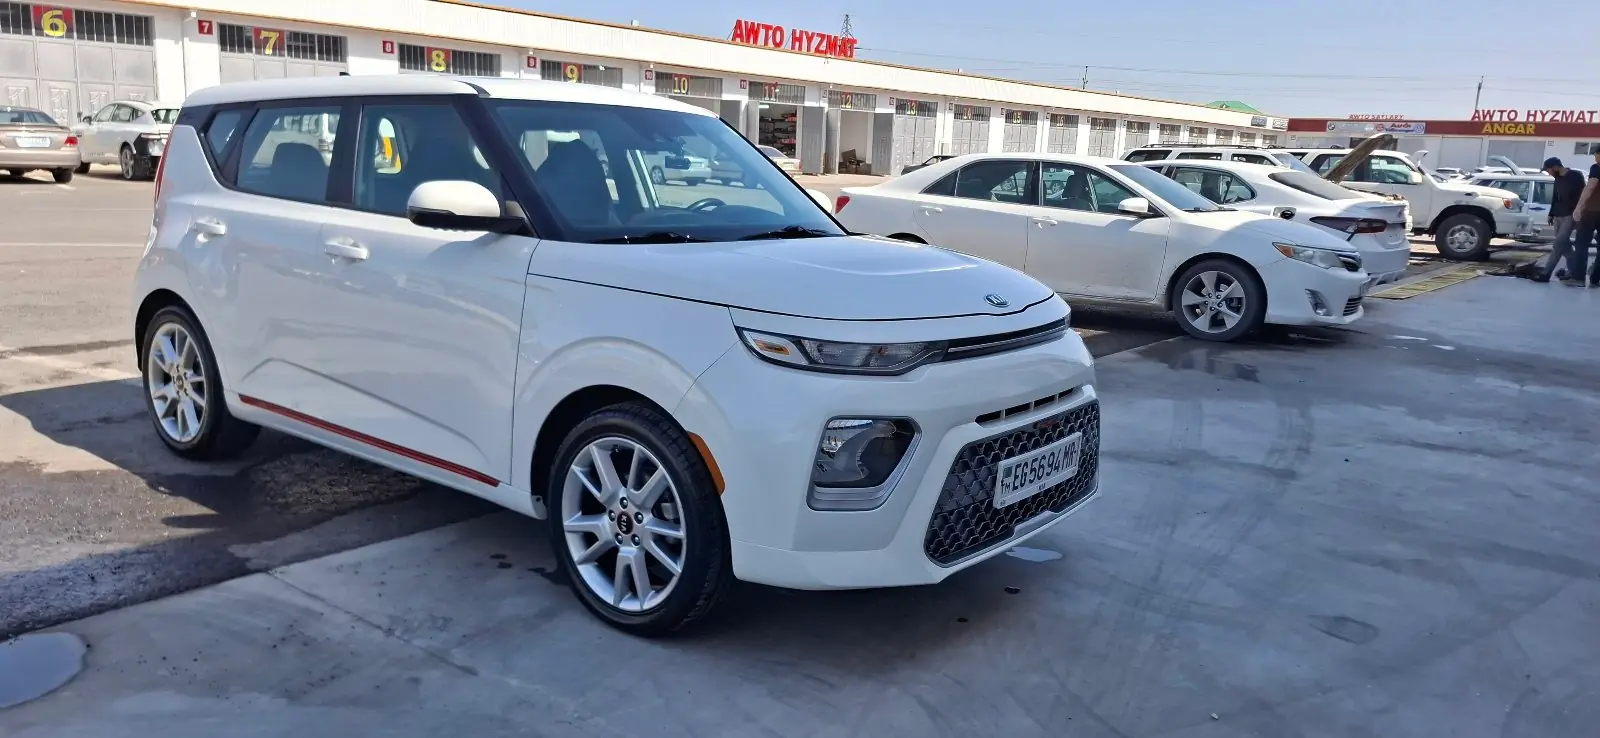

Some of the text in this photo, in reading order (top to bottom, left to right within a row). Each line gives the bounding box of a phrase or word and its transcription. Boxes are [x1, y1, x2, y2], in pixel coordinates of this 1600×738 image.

[41, 10, 67, 37] 6
[202, 22, 210, 33] 7
[259, 30, 280, 56] 7
[732, 19, 857, 58] AWTO HYZMAT
[385, 42, 392, 53] 8
[431, 49, 447, 72] 8
[529, 57, 535, 68] 9
[565, 64, 580, 83] 9
[645, 71, 653, 80] 10
[673, 76, 688, 94] 10
[740, 80, 748, 89] 11
[764, 85, 777, 101] 11
[841, 93, 852, 109] 12
[906, 101, 917, 116] 13
[1471, 109, 1598, 122] AWTO HYZMAT
[1482, 123, 1536, 134] ANGAR
